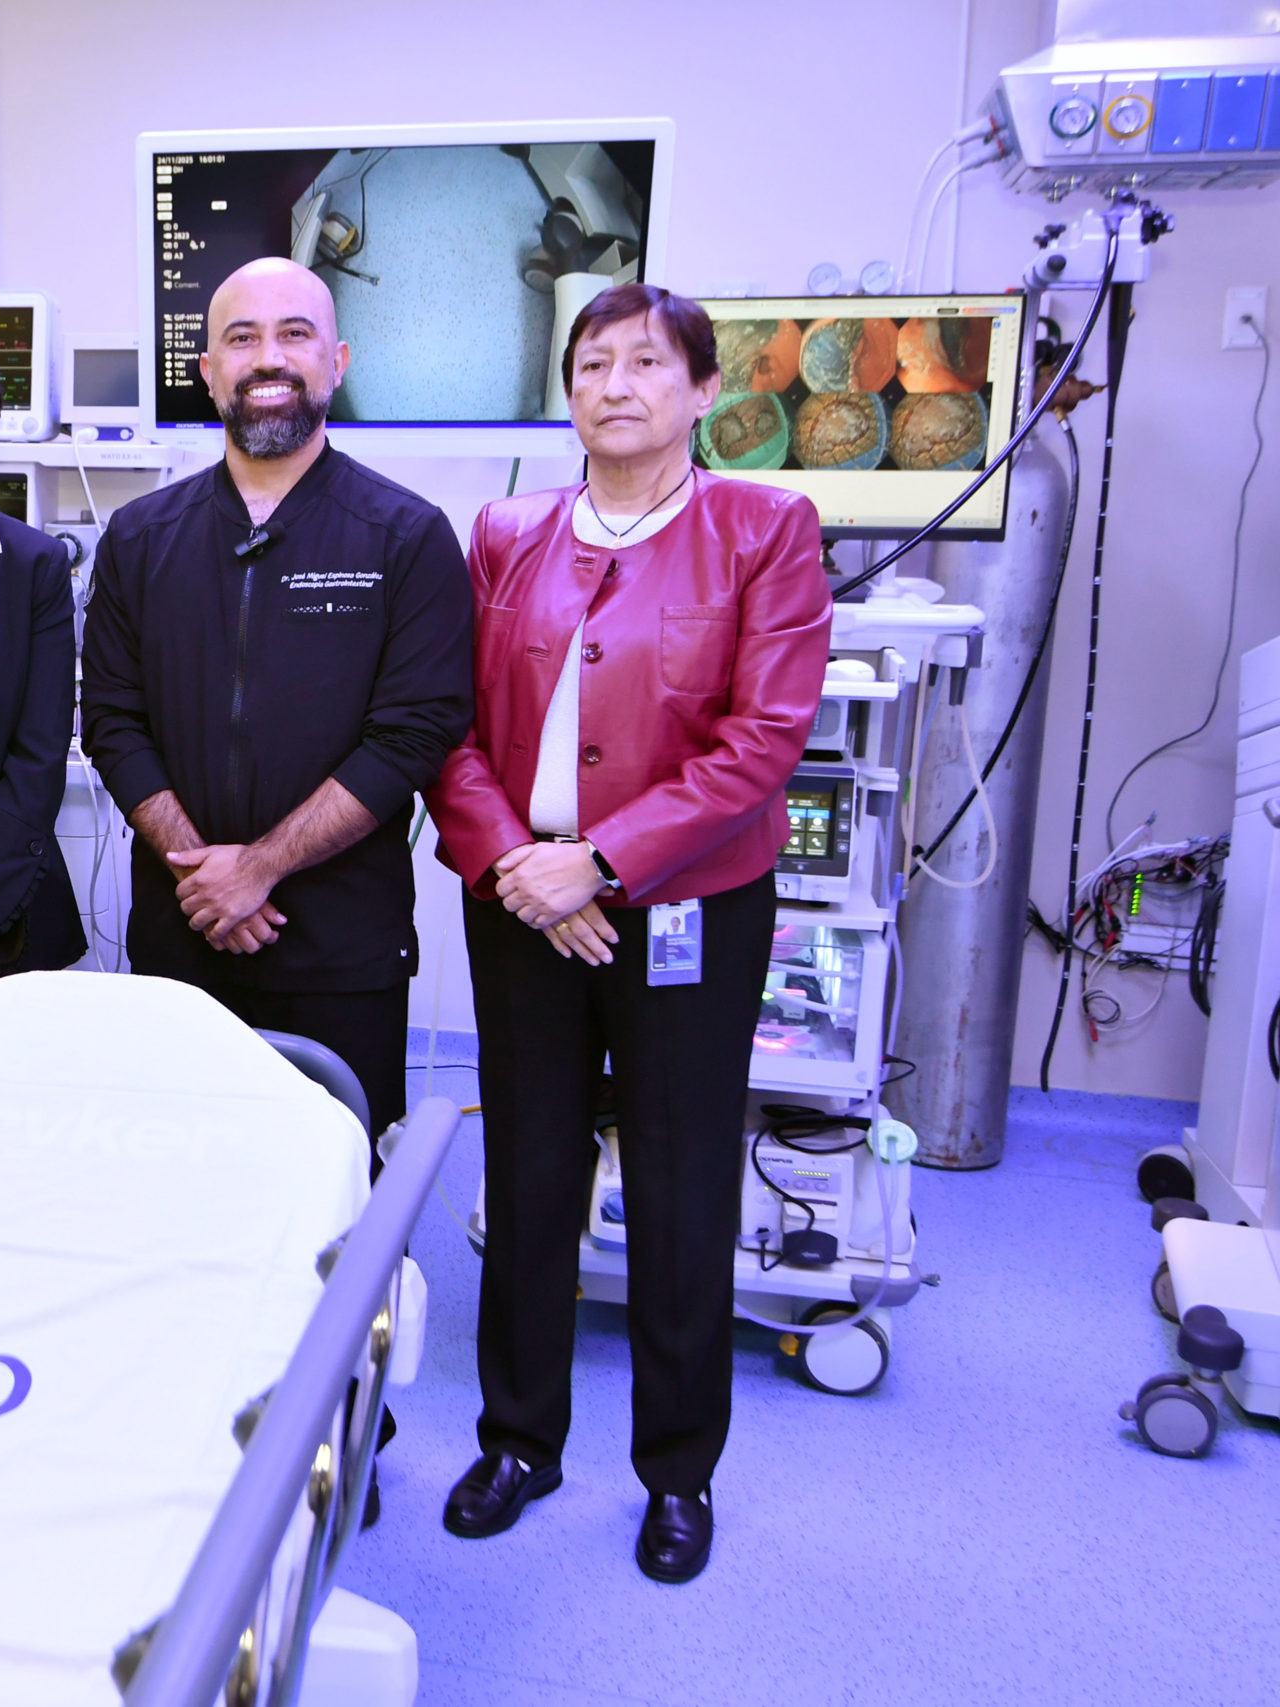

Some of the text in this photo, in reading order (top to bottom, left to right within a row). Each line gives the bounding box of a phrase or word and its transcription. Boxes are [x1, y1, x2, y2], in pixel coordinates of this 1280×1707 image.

[157, 156, 193, 164] 24/11/2025
[174, 352, 200, 360] Disparo
[307, 572, 328, 581] Miguel
[328, 572, 355, 581] Espinosa
[356, 572, 383, 580] González
